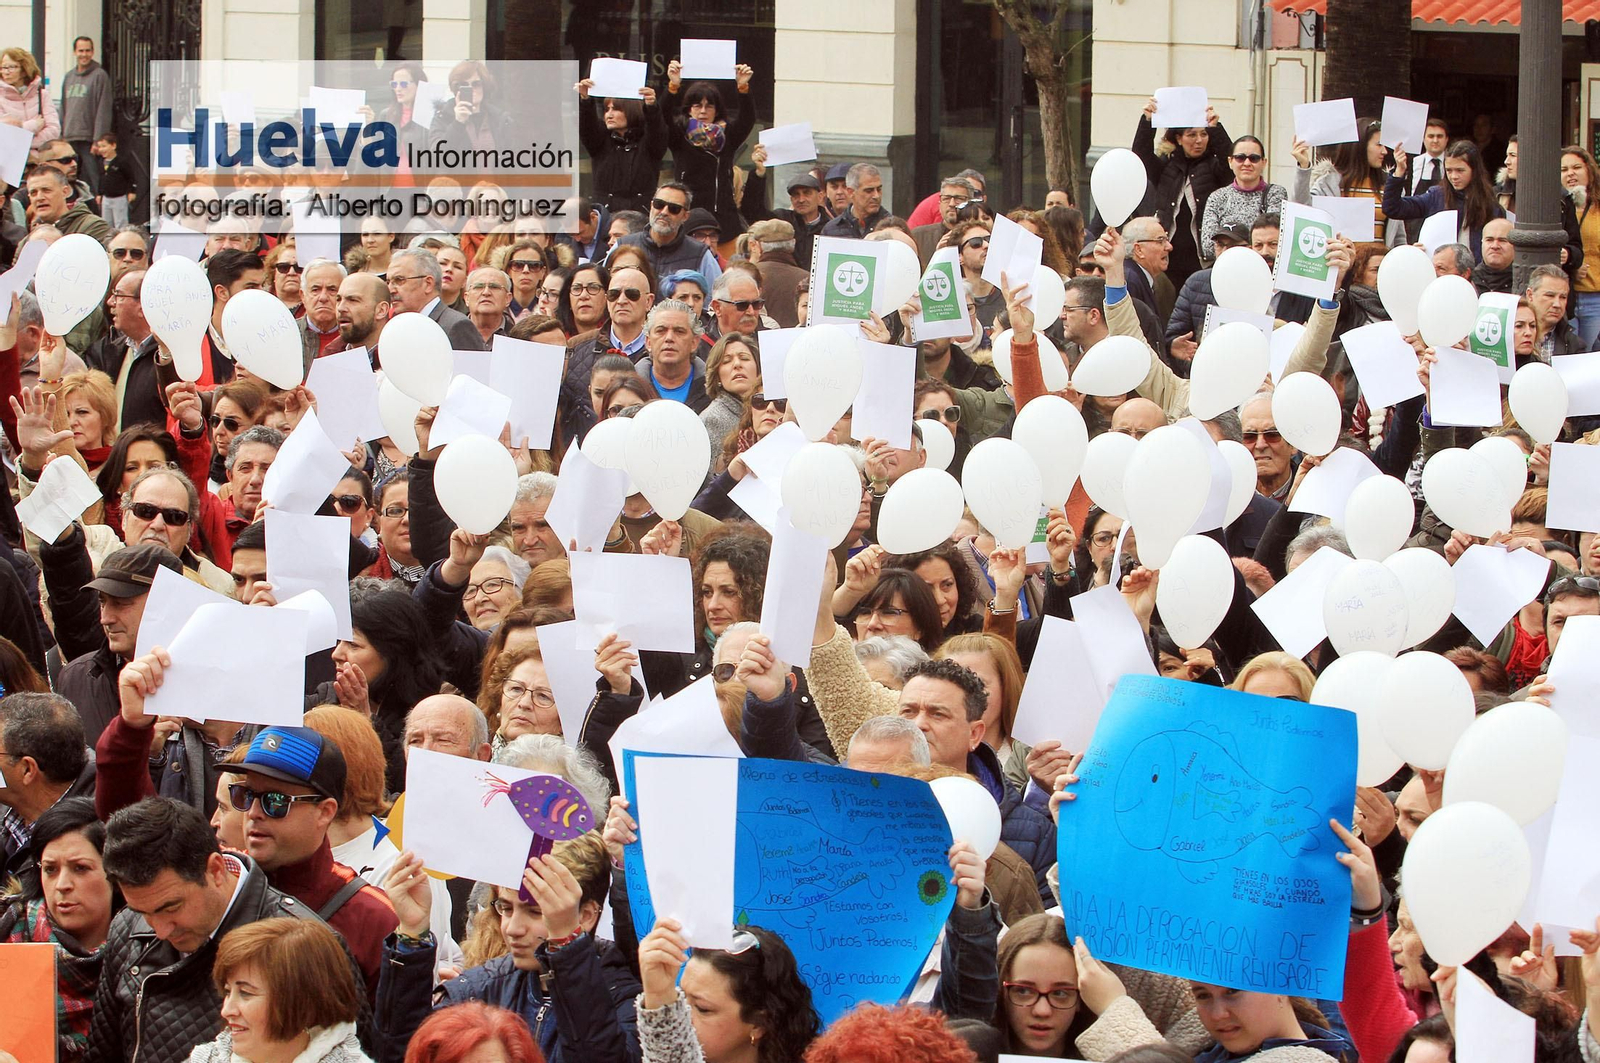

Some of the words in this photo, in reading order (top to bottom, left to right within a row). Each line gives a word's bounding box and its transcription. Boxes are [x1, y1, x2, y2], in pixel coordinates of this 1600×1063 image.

[781, 768, 799, 784] de
[1170, 835, 1207, 852] Gabriel
[1274, 876, 1289, 886] LOS
[765, 888, 795, 906] José
[1285, 887, 1321, 897] CUANDO
[877, 901, 896, 911] con
[1085, 893, 1101, 927] A
[1108, 899, 1128, 932] LA
[1136, 904, 1258, 957] DEROGACION
[1279, 931, 1317, 963] DE
[861, 928, 919, 951] Podemos!
[1083, 923, 1138, 960] PRISION
[1145, 937, 1238, 984] PERMANENTE
[1242, 955, 1329, 996] REVISABLE
[800, 963, 847, 996] Sigue
[849, 970, 901, 986] nadando
